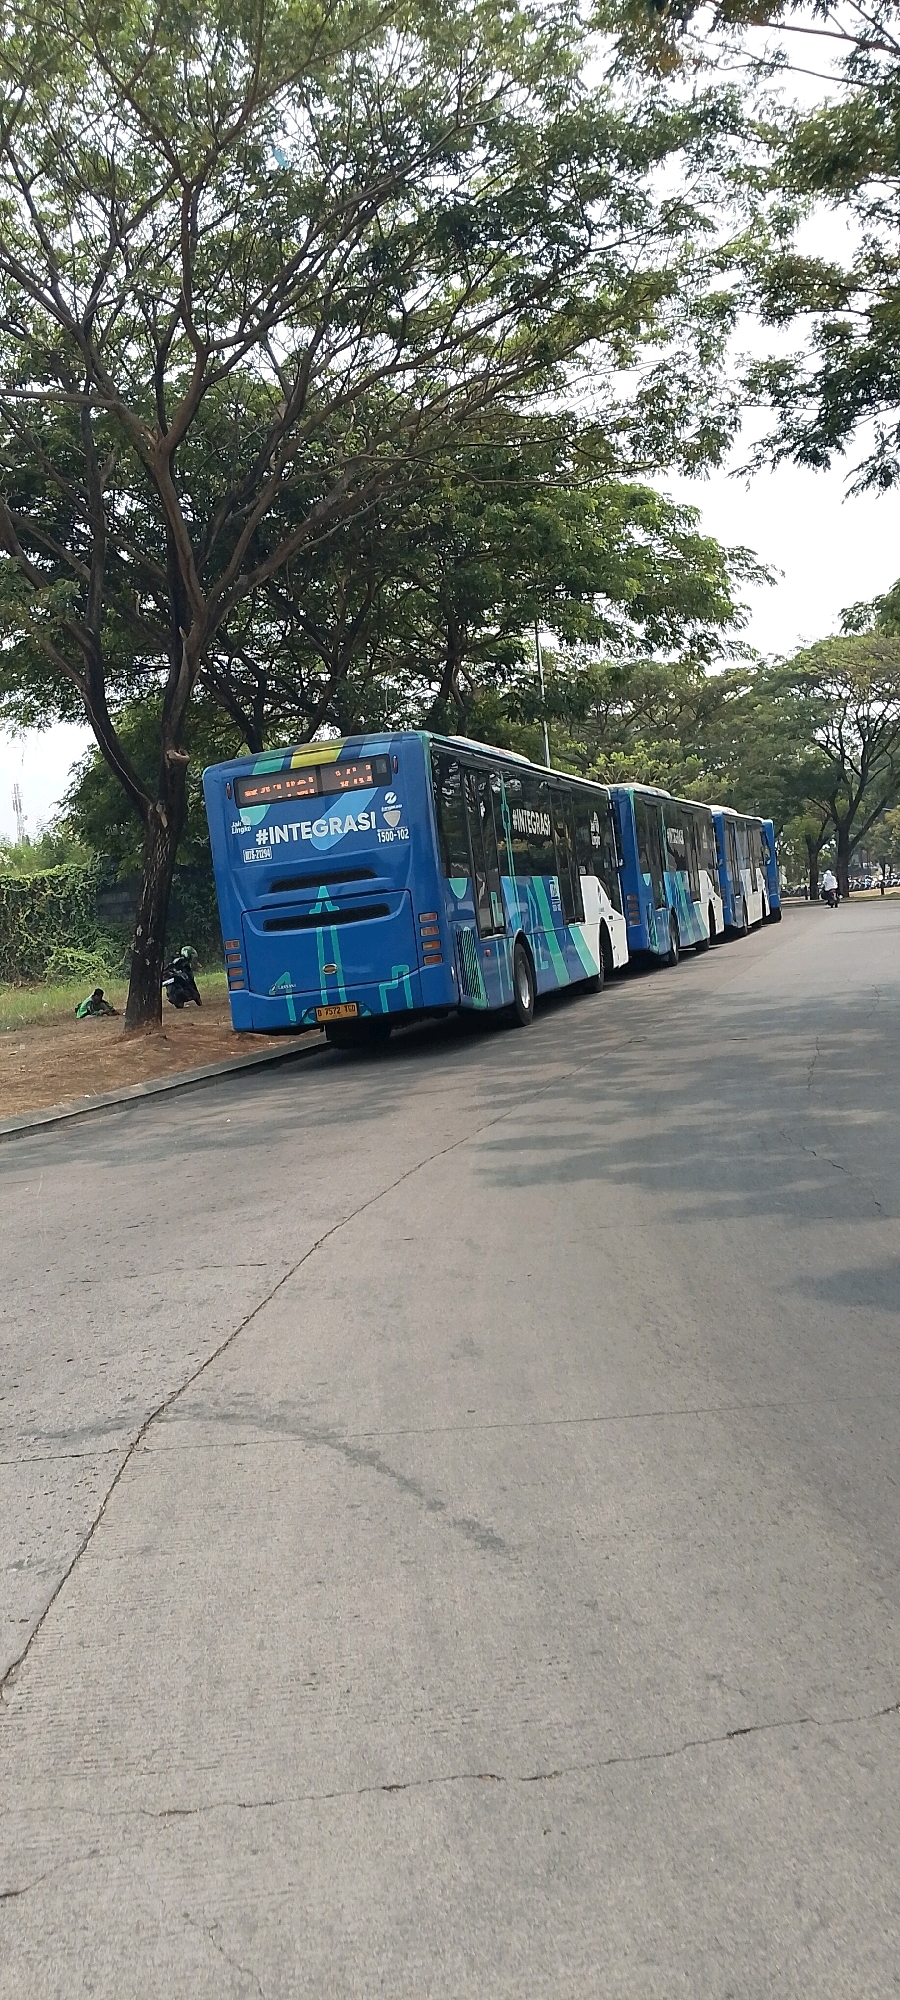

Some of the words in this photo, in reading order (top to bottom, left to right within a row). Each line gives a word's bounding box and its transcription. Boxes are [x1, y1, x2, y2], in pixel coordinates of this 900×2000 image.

[255, 811, 377, 846] #INTEGRASI
[377, 828, 410, 843] 1500-102
[324, 1006, 341, 1016] 7572
